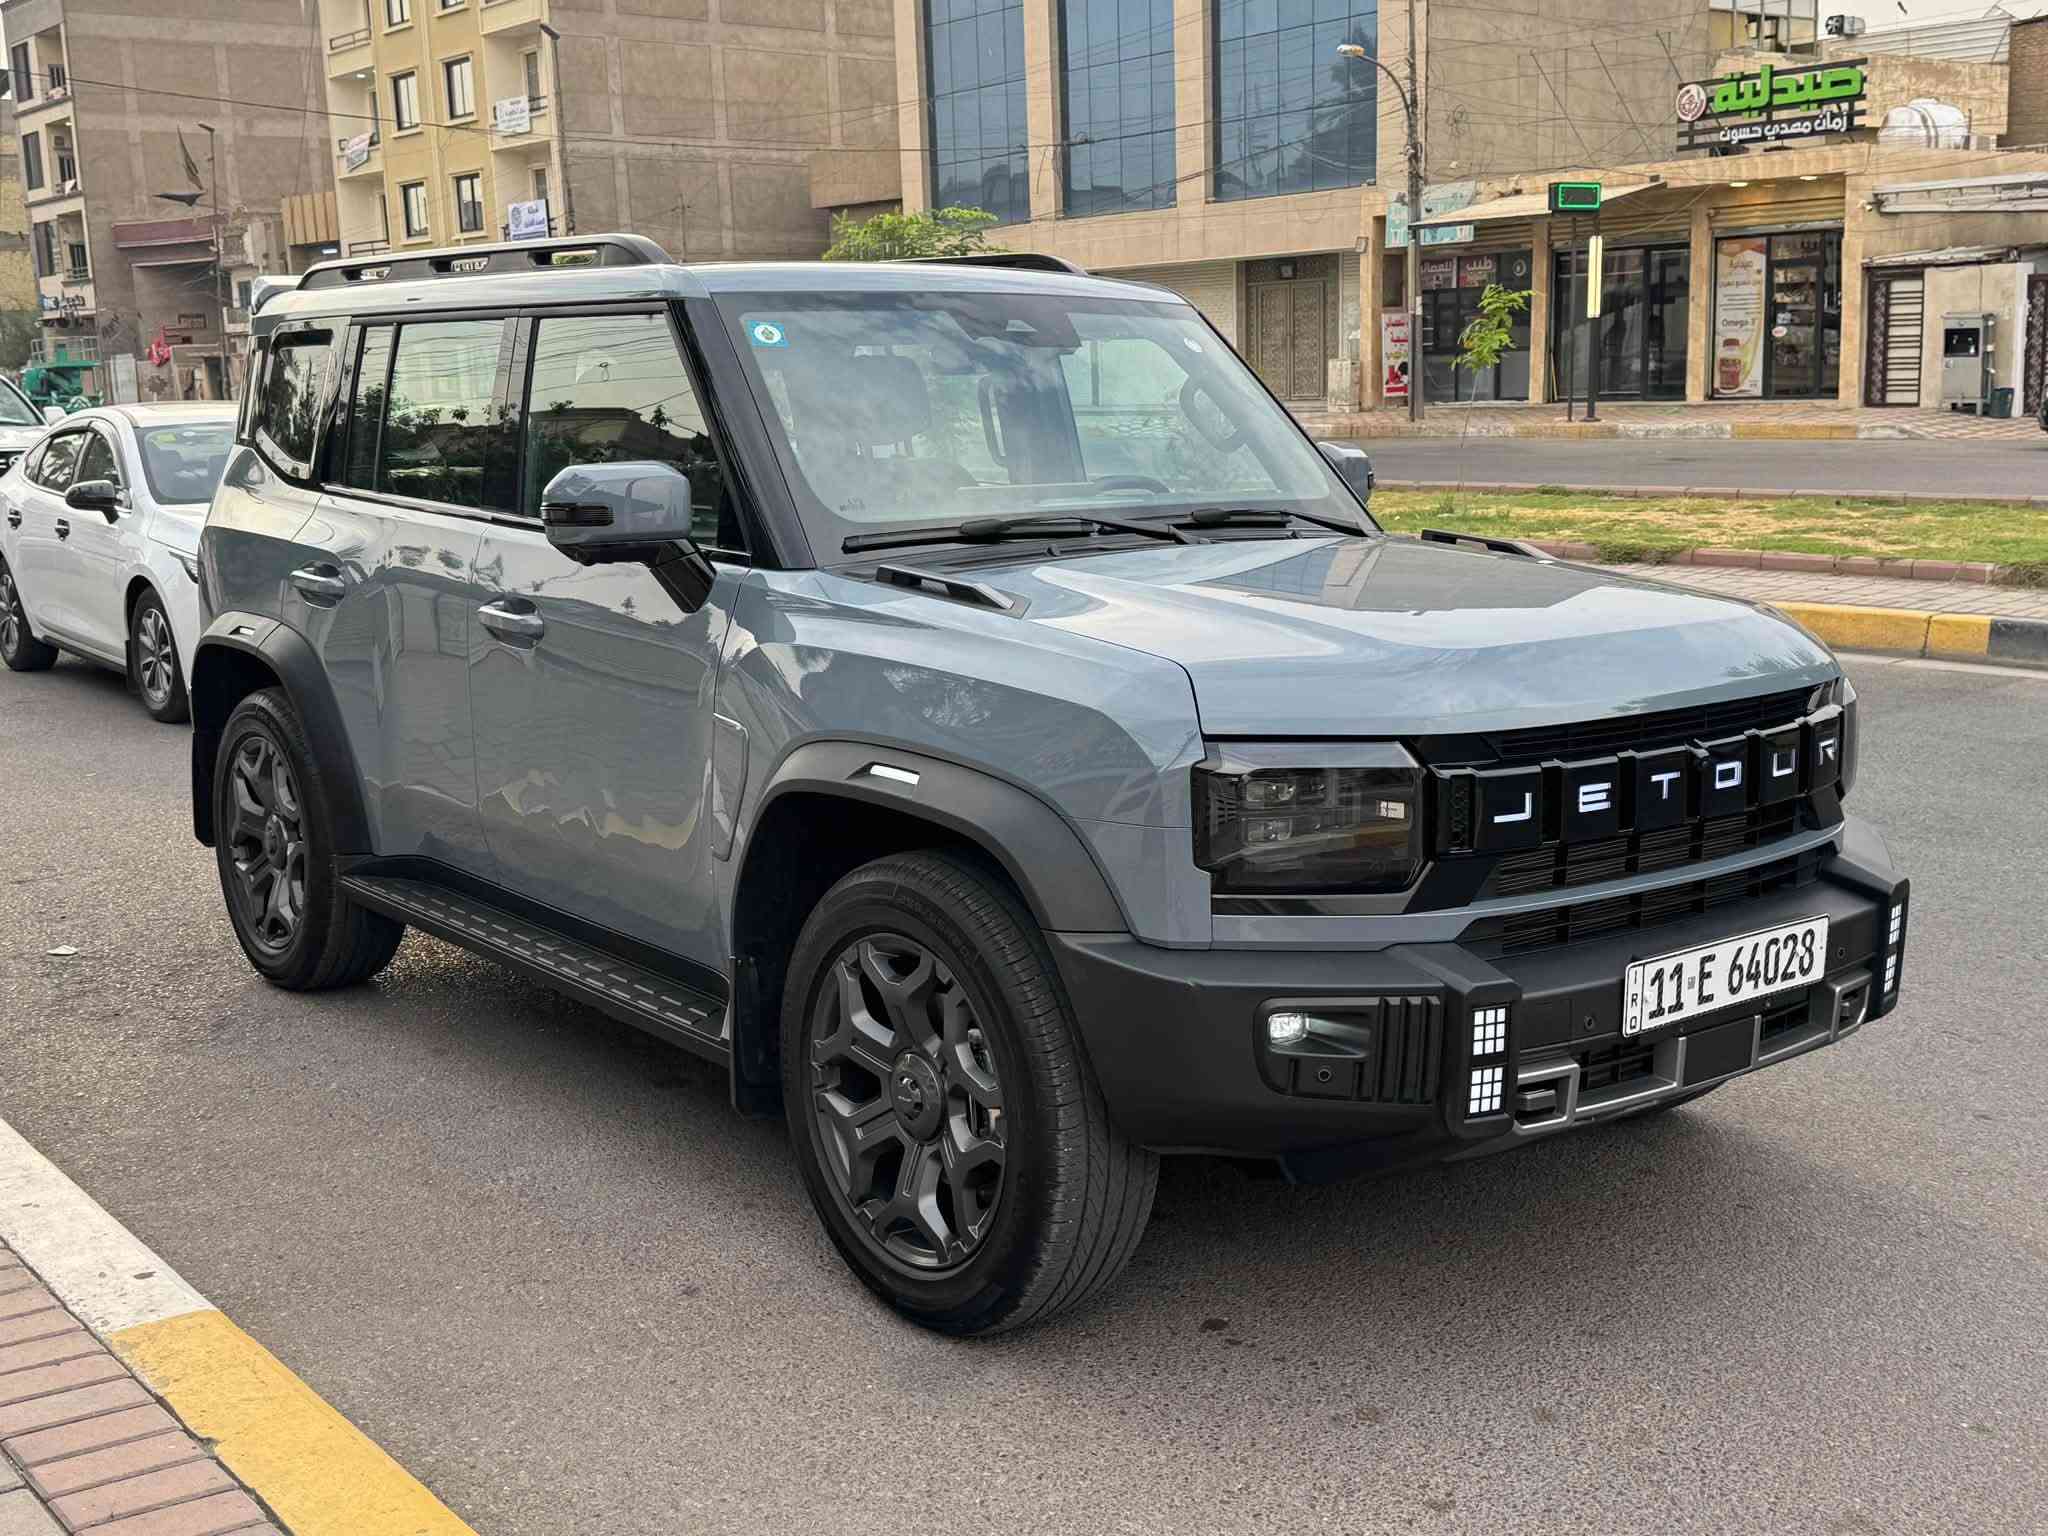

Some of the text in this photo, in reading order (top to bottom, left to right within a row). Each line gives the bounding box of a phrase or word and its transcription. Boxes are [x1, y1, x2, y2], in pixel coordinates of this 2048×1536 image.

[1715, 65, 1863, 119] صيدلية
[1719, 112, 1848, 145] زمان مهدي حسون
[1494, 738, 1836, 823] JETOUR
[1629, 970, 1638, 1031] IRQ
[1649, 928, 1815, 1019] 11 E 64028
